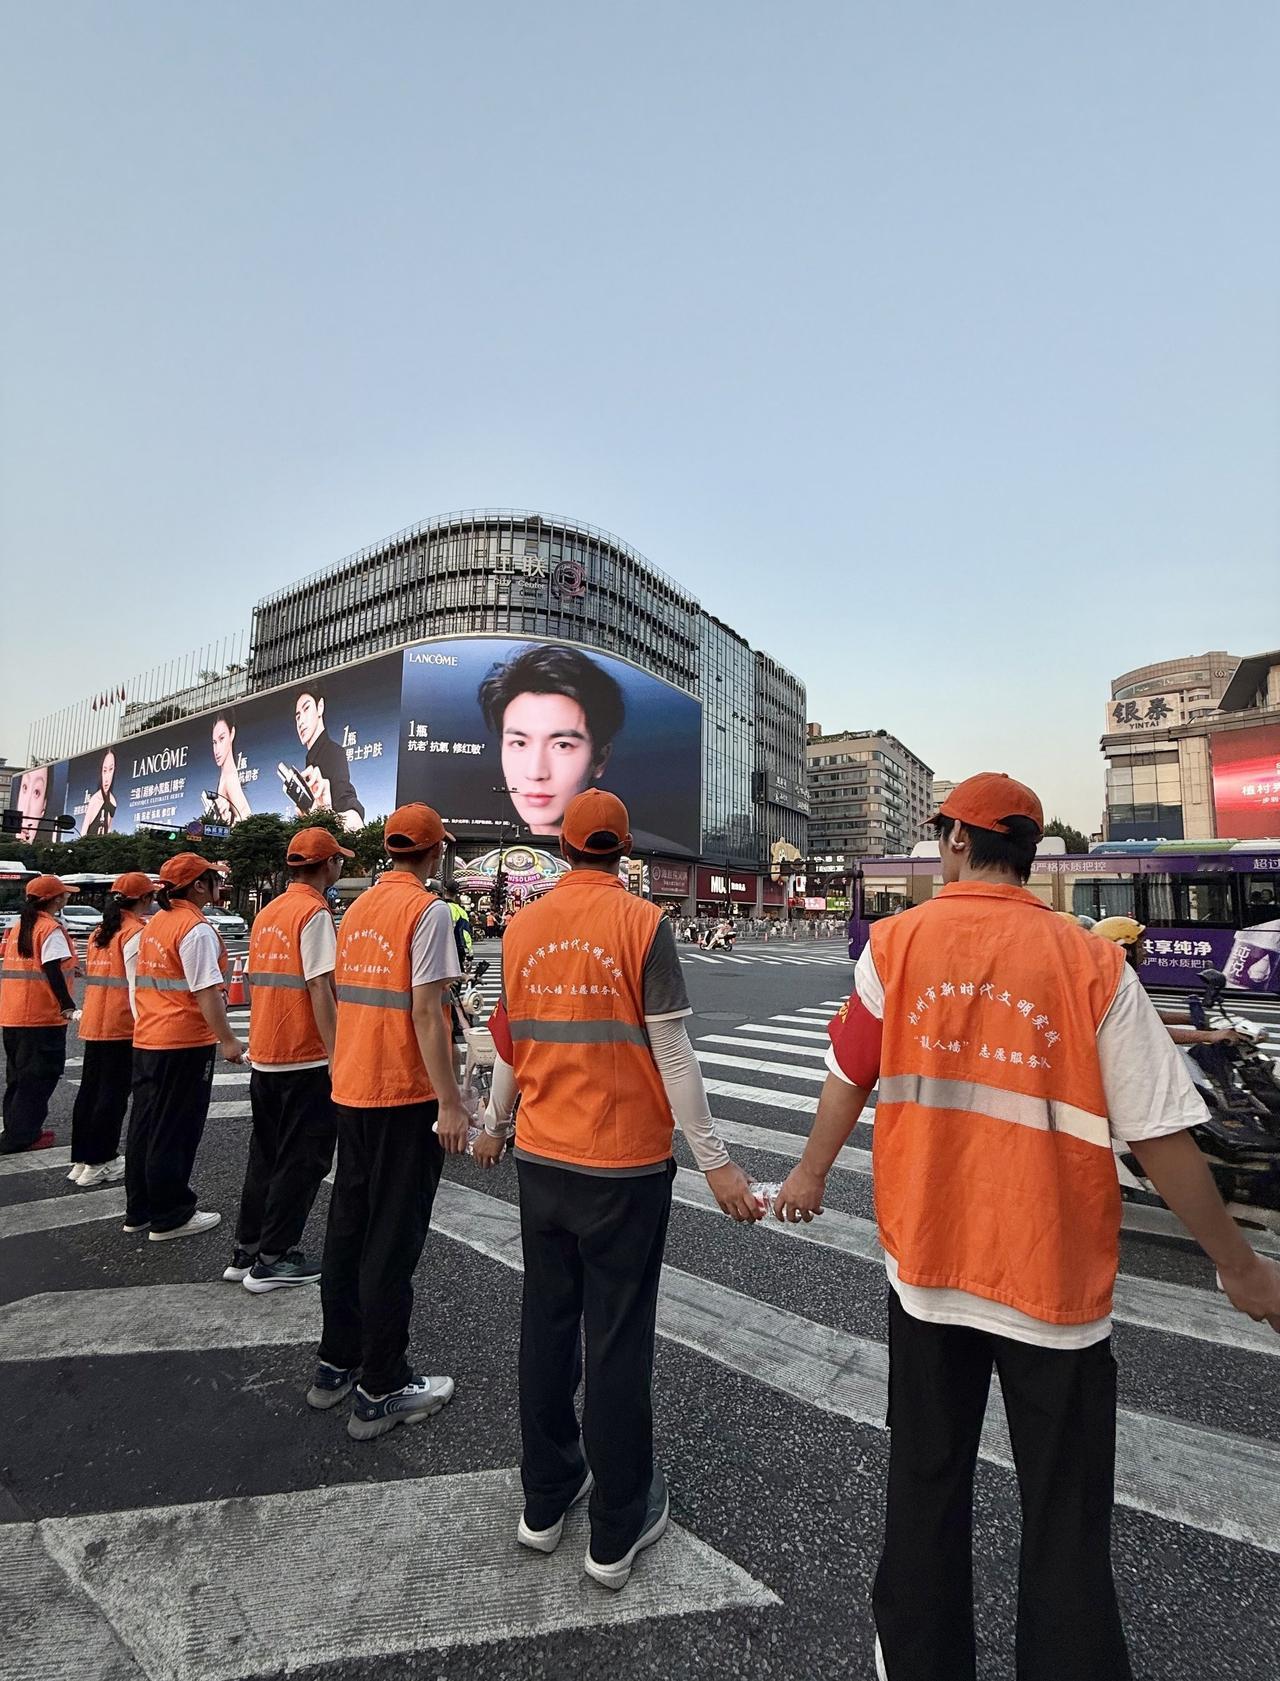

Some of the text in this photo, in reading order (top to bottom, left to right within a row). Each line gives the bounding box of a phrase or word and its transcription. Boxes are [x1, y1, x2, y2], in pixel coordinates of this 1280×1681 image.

[493, 554, 546, 578] 工联
[409, 653, 458, 666] LANCÔME
[1112, 697, 1174, 724] 银泰
[1129, 721, 1160, 730] YINTAI
[132, 746, 189, 779] LANCÔME
[346, 741, 383, 762] 男士护肤
[907, 982, 1062, 1048] 杭州市新时代文明实践
